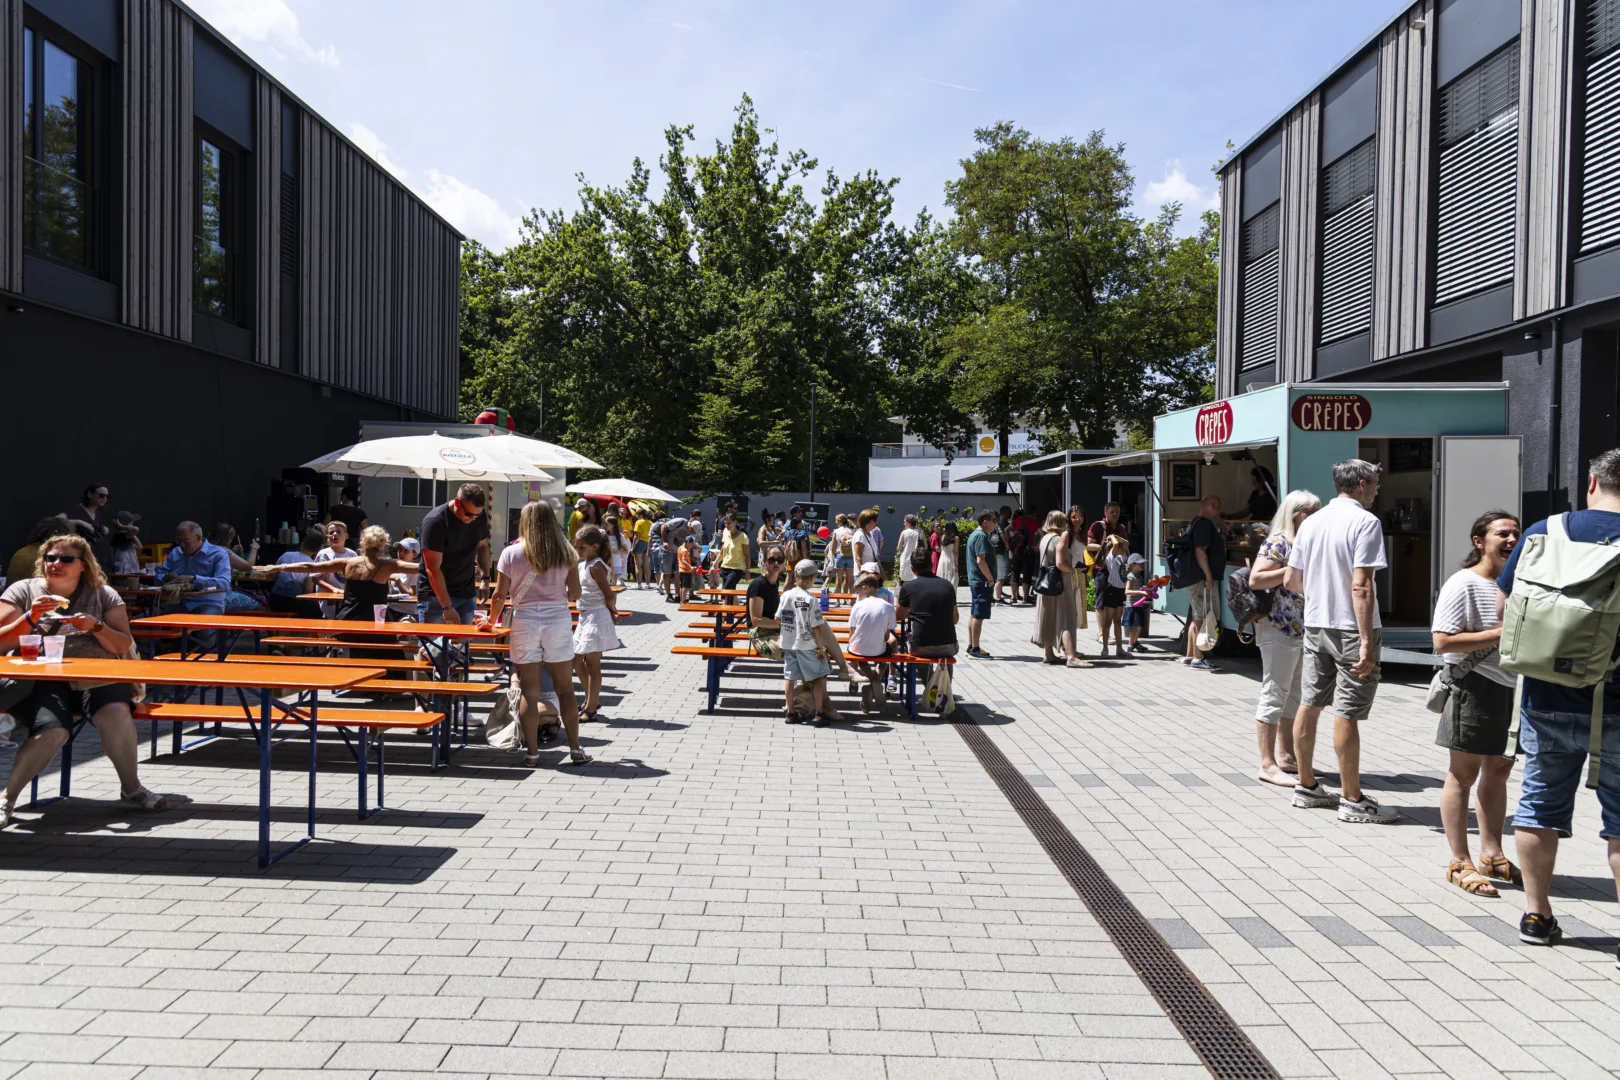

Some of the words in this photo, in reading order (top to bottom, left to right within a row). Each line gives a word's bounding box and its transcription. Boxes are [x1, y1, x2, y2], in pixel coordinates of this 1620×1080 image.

[1202, 402, 1225, 411] SINGOLD
[1301, 402, 1363, 430] CRÊPES
[1199, 409, 1227, 446] CRÊPES
